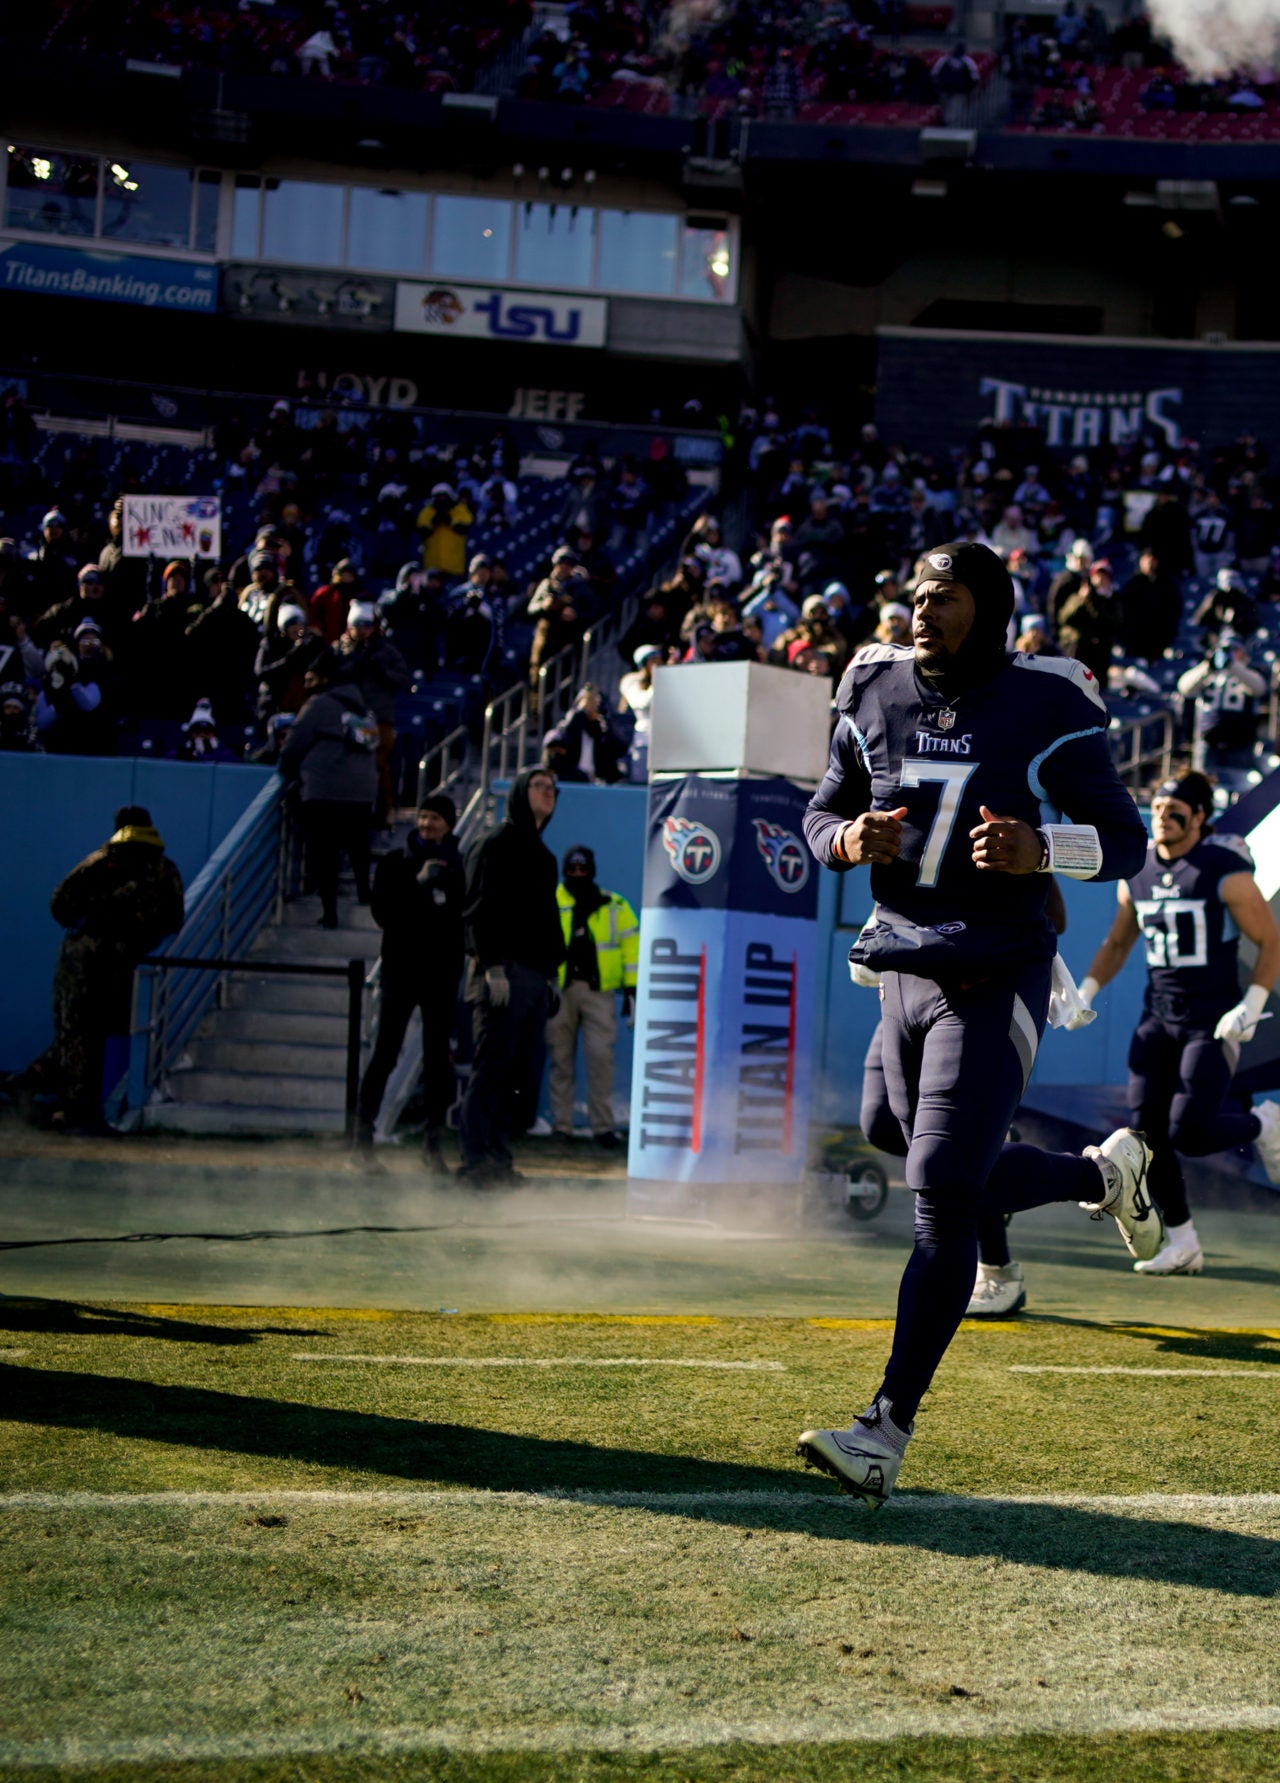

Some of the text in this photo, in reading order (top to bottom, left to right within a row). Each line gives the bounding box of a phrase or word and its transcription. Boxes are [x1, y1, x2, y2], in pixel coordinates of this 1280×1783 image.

[5, 259, 213, 306] TitansBanking.com
[475, 295, 580, 340] tsu
[508, 387, 586, 422] JEFF
[979, 376, 1184, 450] TITANS
[916, 731, 972, 754] TITANS
[901, 759, 980, 888] 7
[640, 938, 704, 1150] TITAN UP
[734, 942, 795, 1155] TITAN UP
